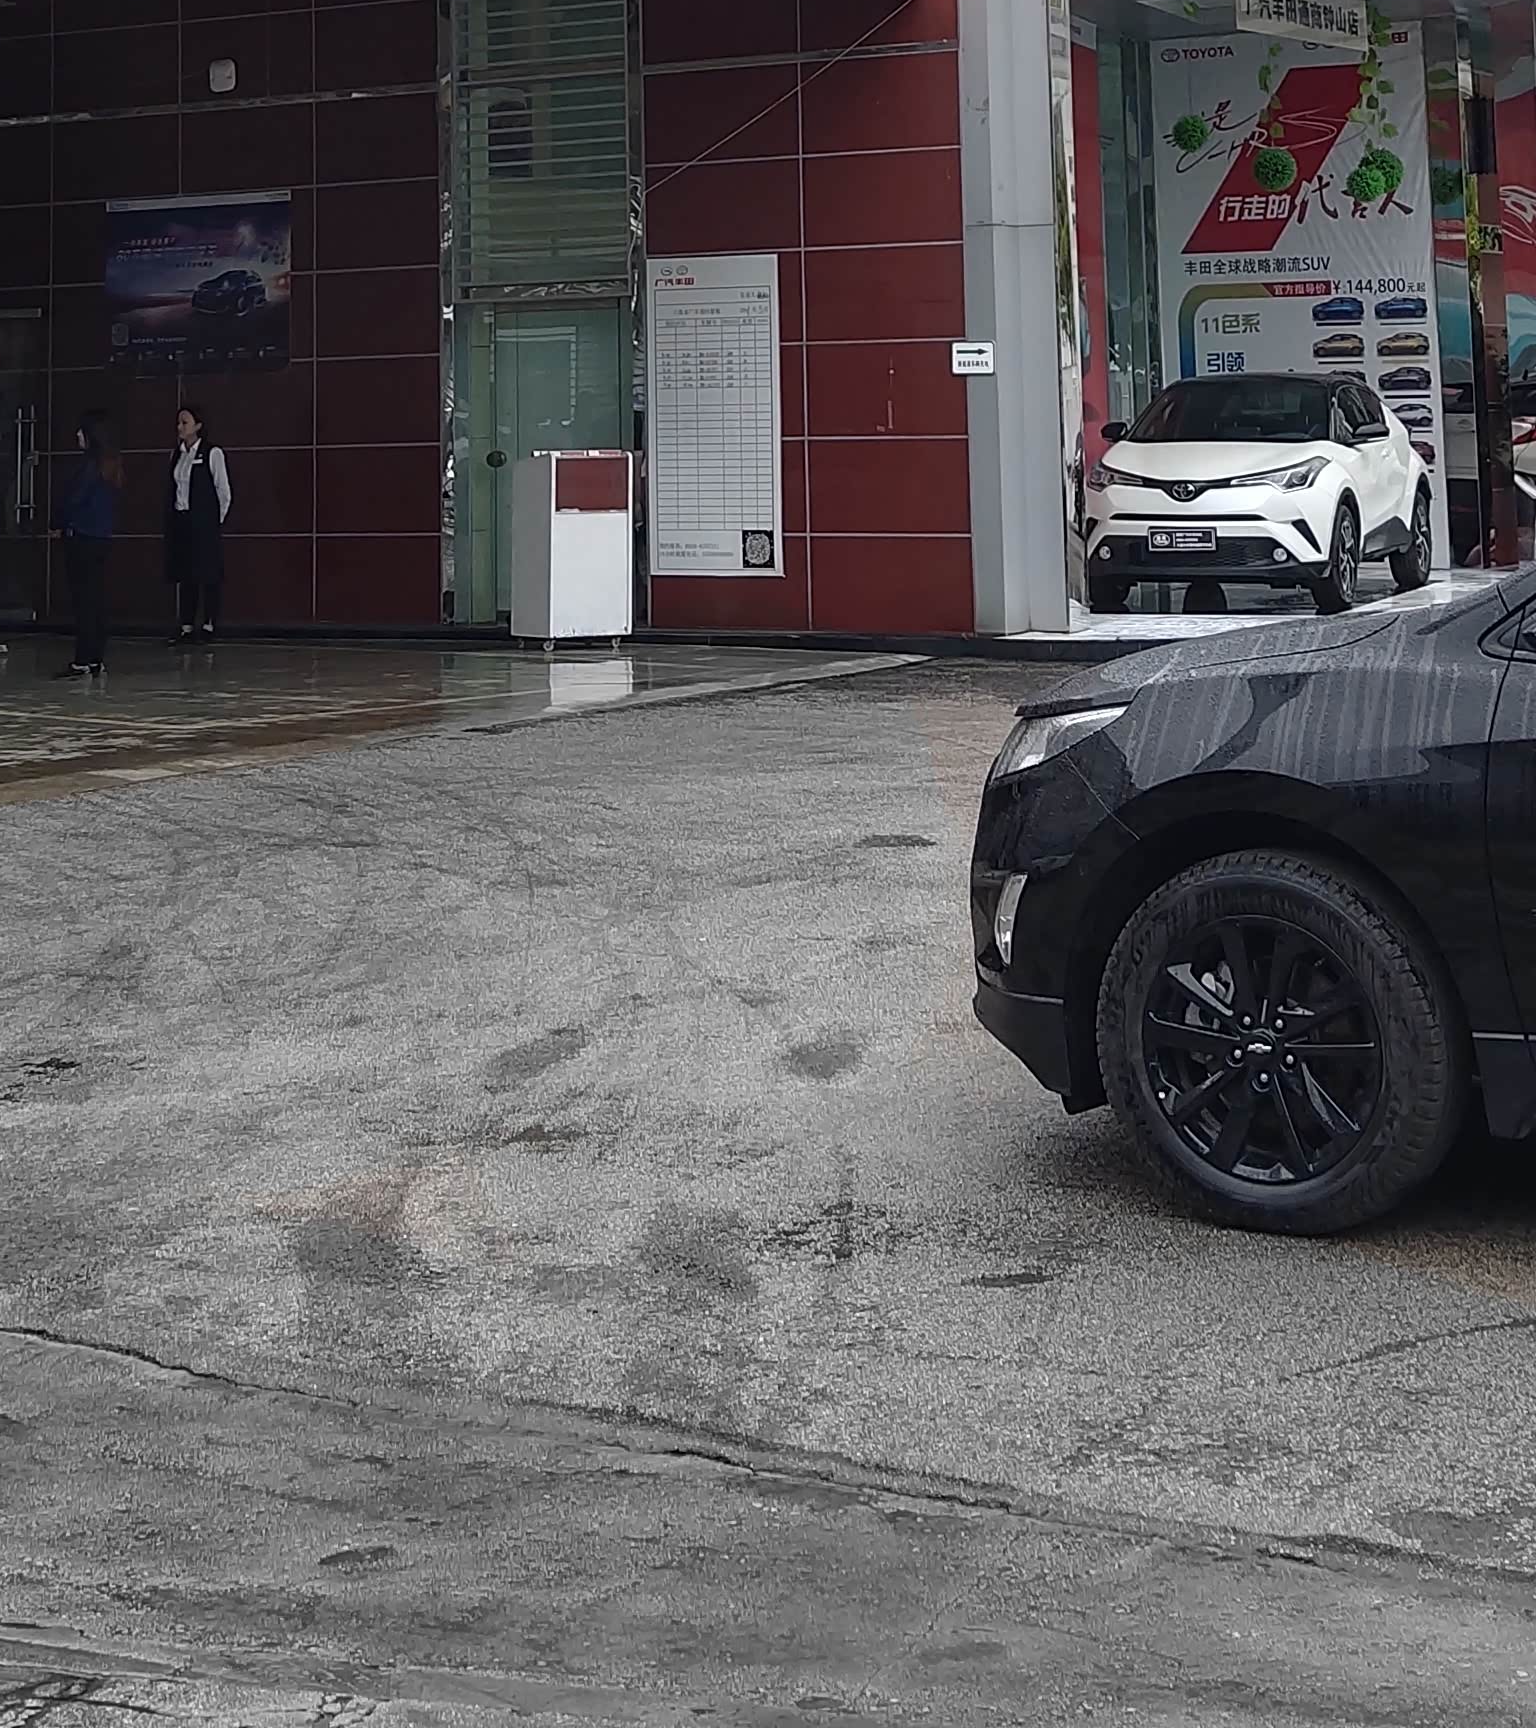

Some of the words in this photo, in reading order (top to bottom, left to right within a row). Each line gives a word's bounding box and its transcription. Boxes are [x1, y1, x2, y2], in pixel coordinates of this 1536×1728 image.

[1181, 46, 1234, 60] TOYOTA
[1183, 256, 1331, 276] 丰田全球战略潮流SUV
[1201, 311, 1261, 334] 11色系
[1206, 350, 1245, 373] 引领
